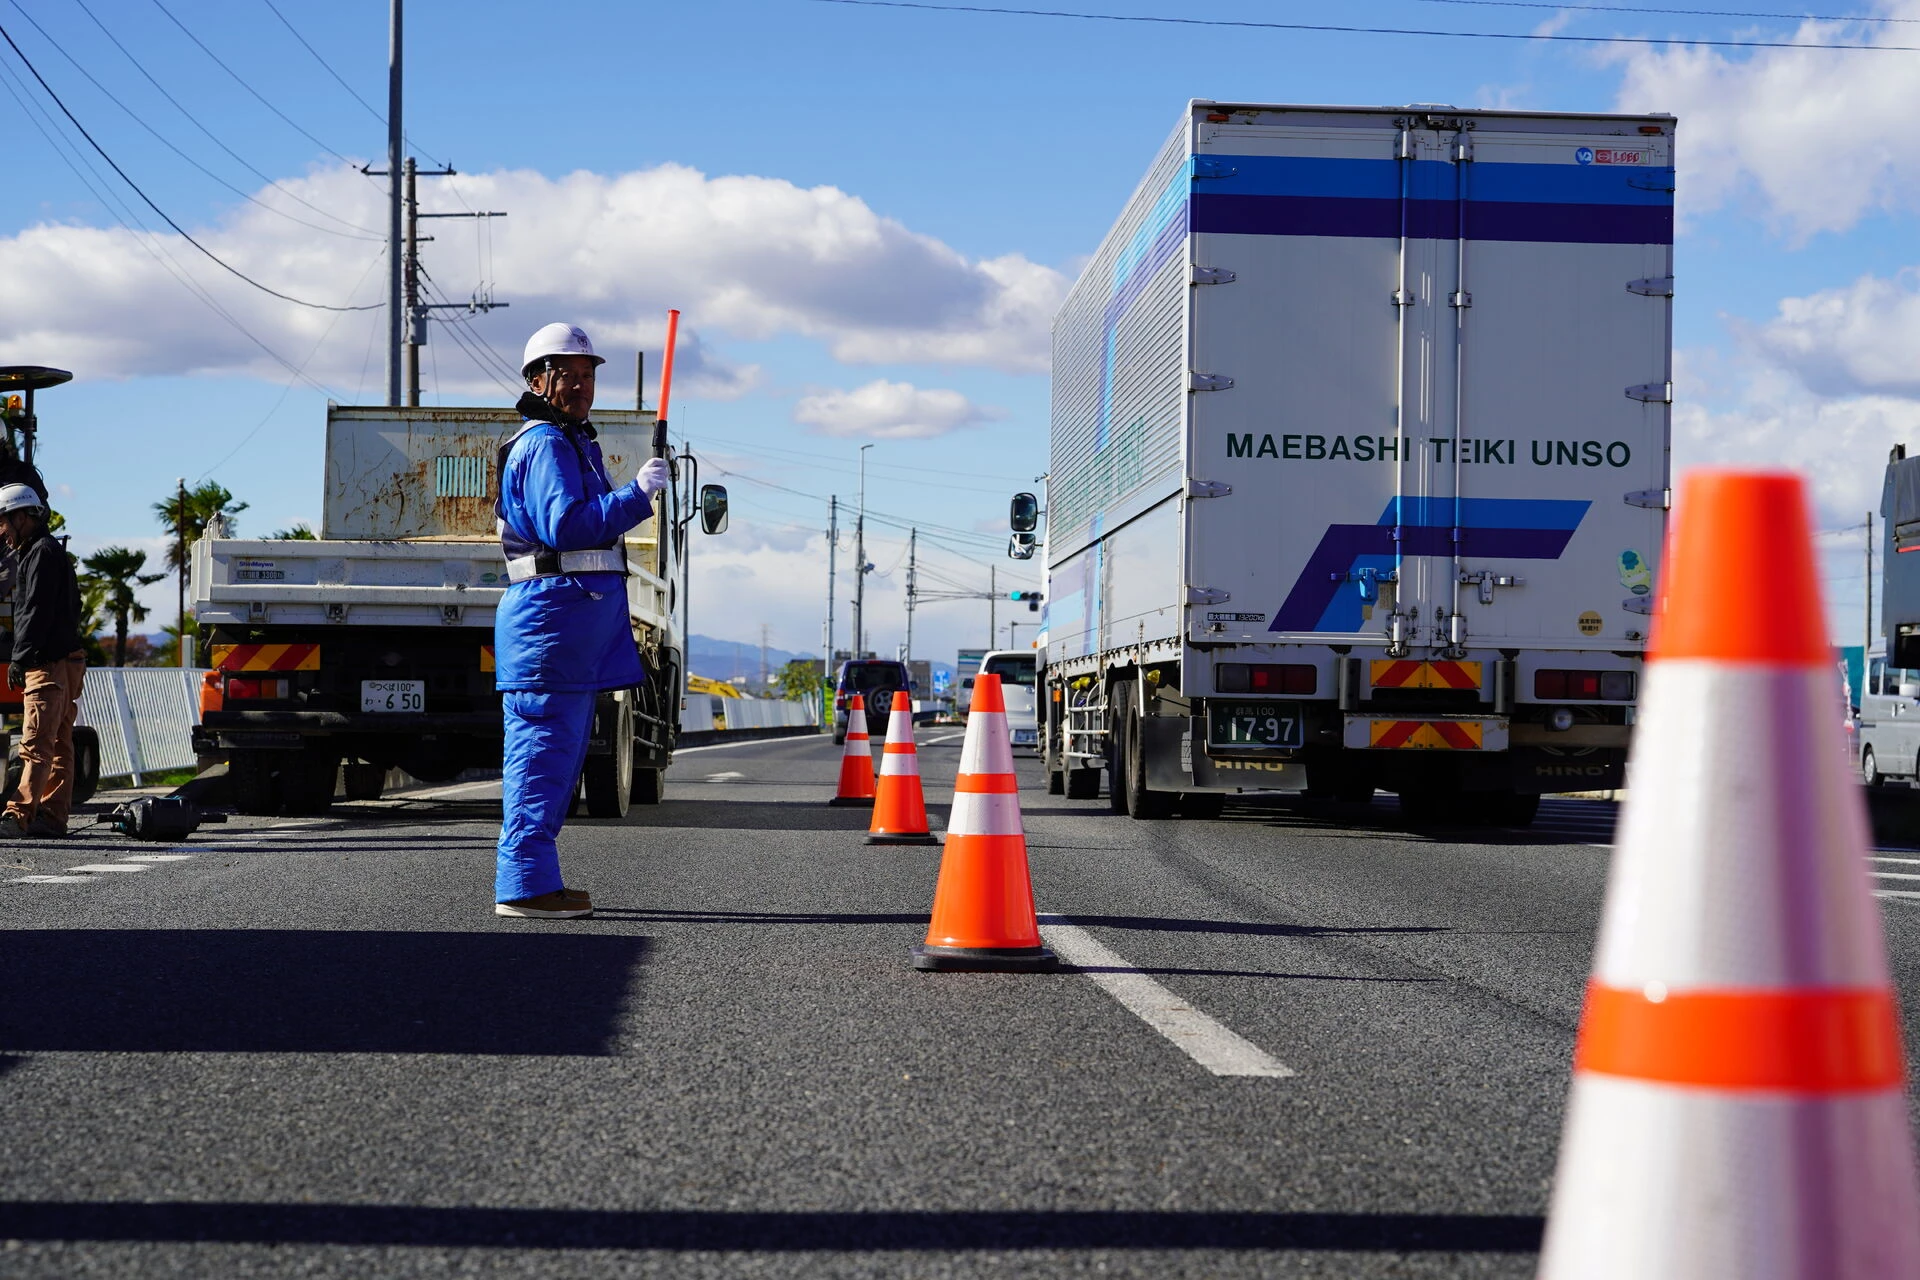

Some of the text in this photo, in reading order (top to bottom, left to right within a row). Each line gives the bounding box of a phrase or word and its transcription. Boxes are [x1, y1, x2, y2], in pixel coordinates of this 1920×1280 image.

[1226, 433, 1631, 467] MAEBASHI TEIKI UNSO
[1231, 717, 1294, 742] 17-97
[1536, 766, 1604, 776] HINO
